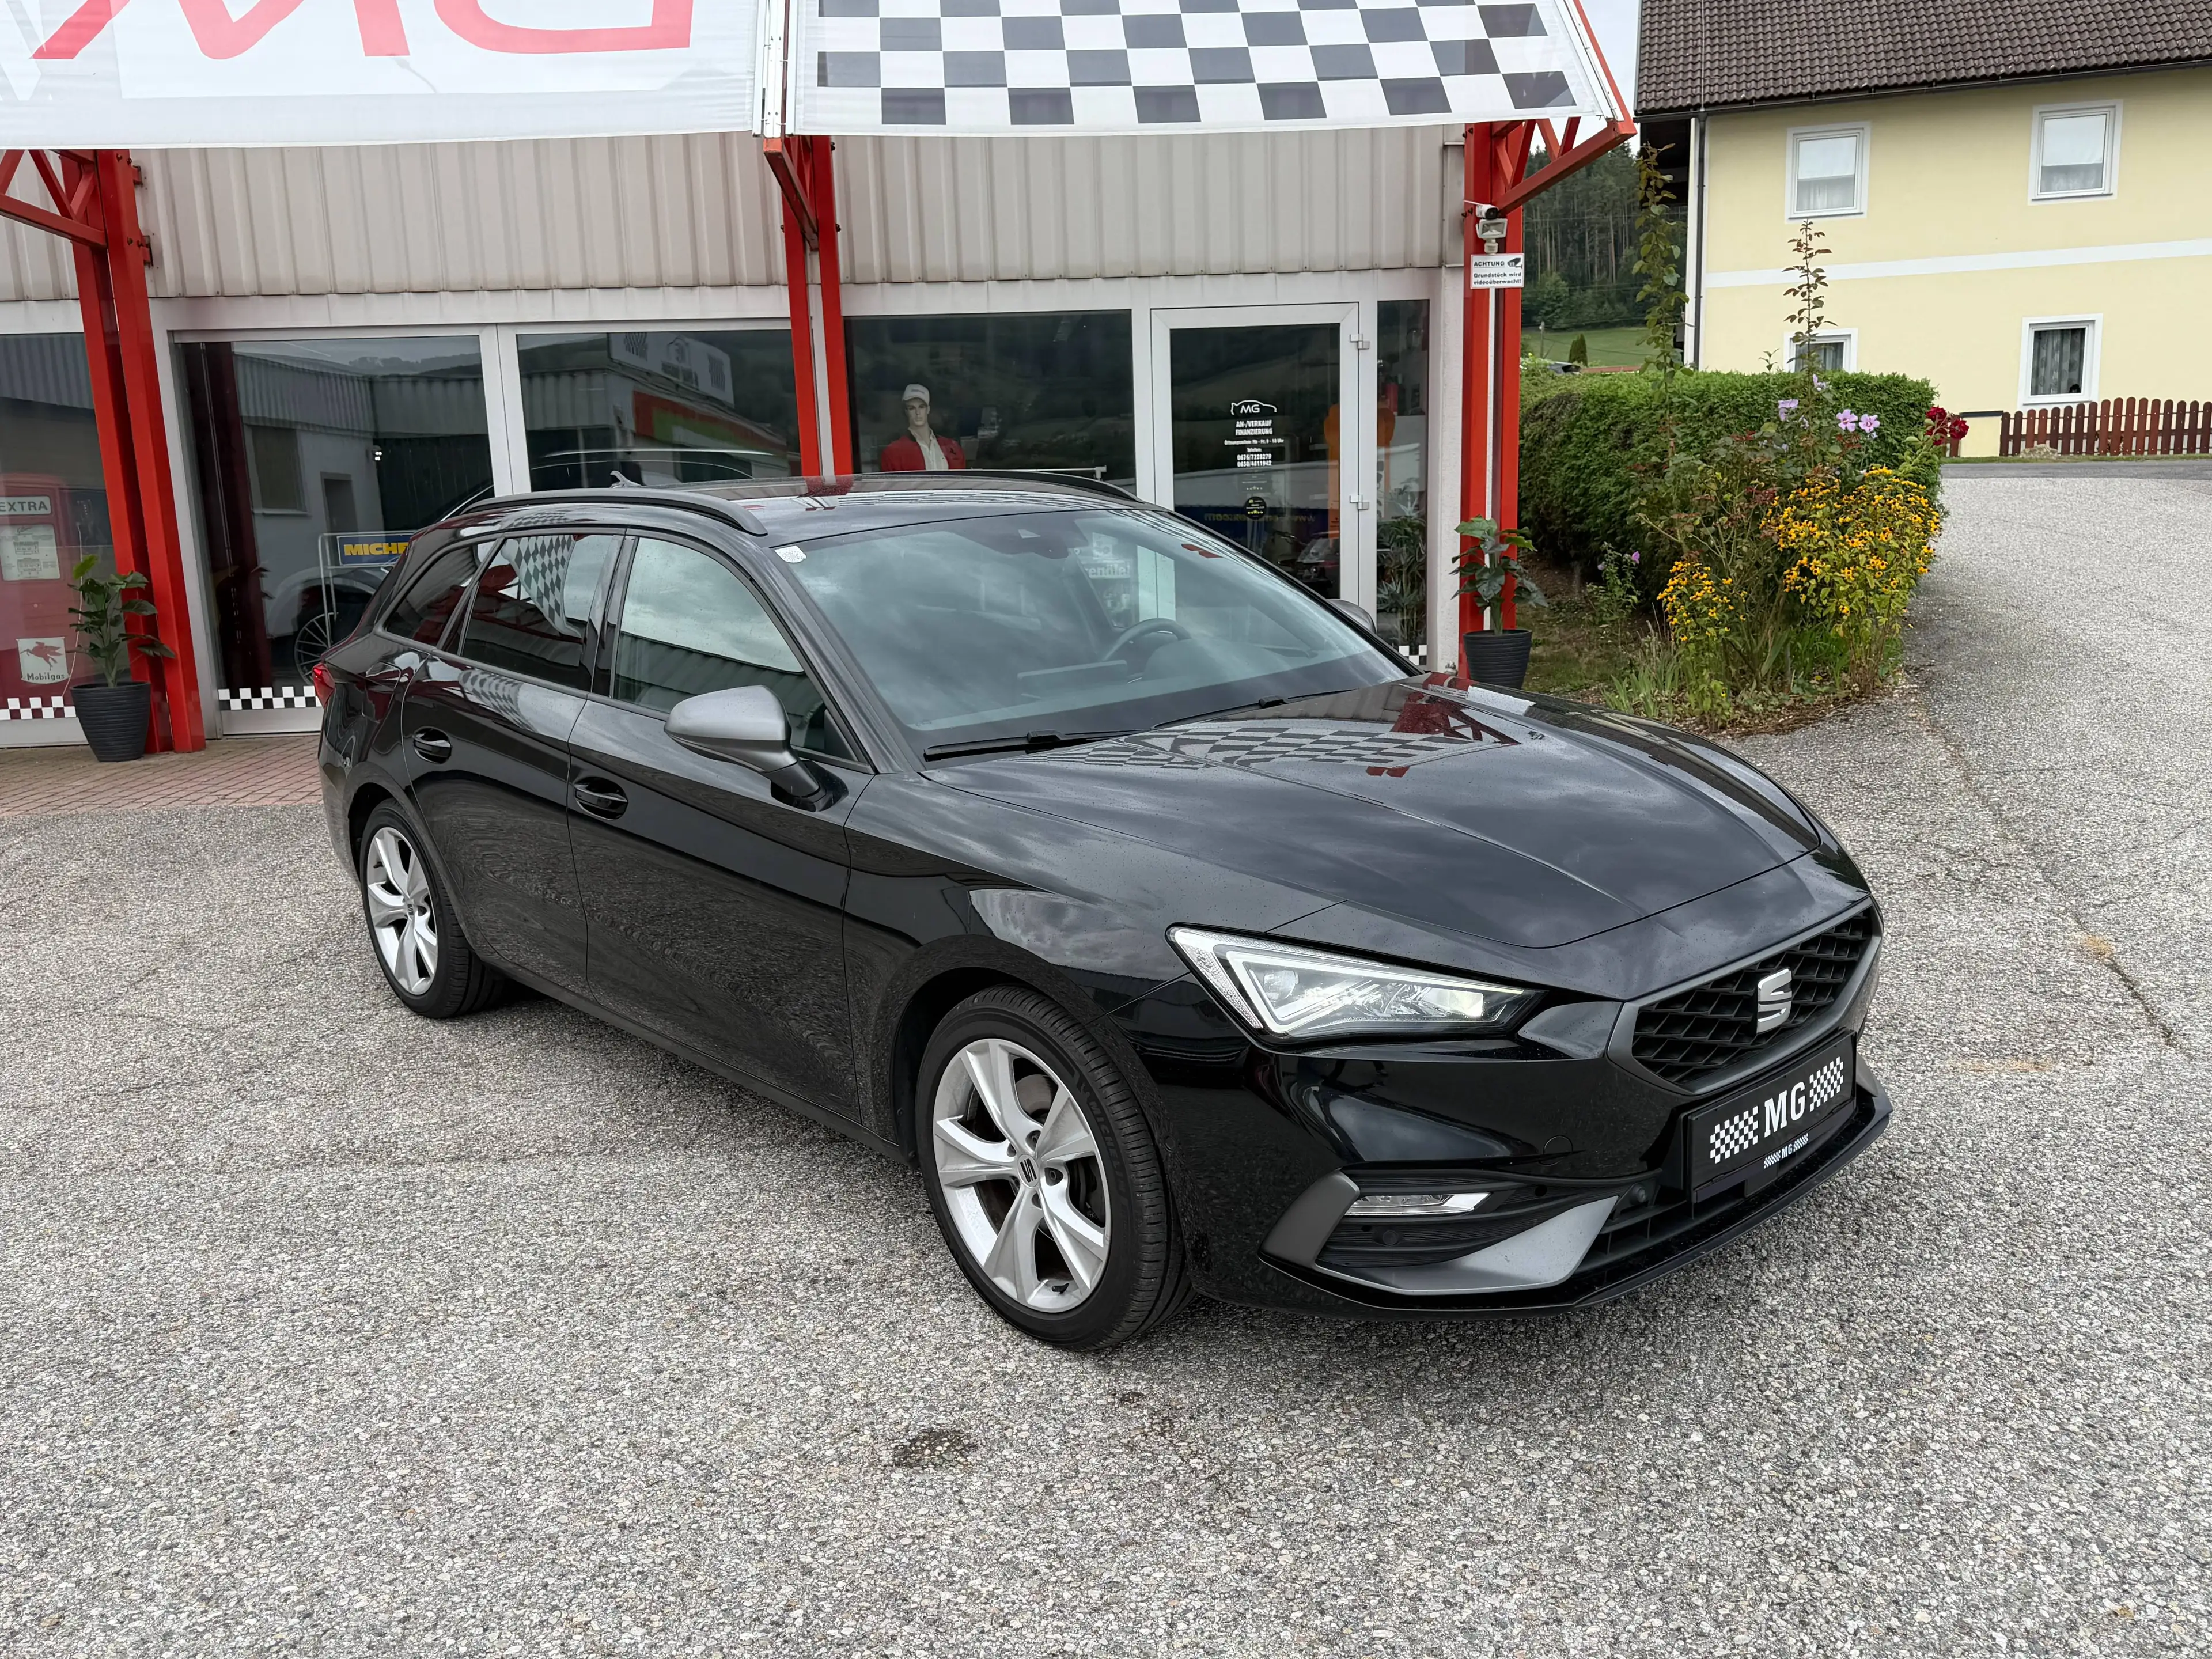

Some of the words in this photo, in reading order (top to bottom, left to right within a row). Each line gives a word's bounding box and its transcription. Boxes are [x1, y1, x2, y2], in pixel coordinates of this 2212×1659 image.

[1240, 404, 1260, 414] MG
[1236, 419, 1272, 428] AN-/VERKAUF
[1235, 428, 1273, 436] FINANZIERUNG
[0, 501, 48, 512] EXTRA
[26, 672, 65, 681] Mobilgas
[1764, 1081, 1806, 1138] MG
[1782, 1143, 1793, 1159] MG
